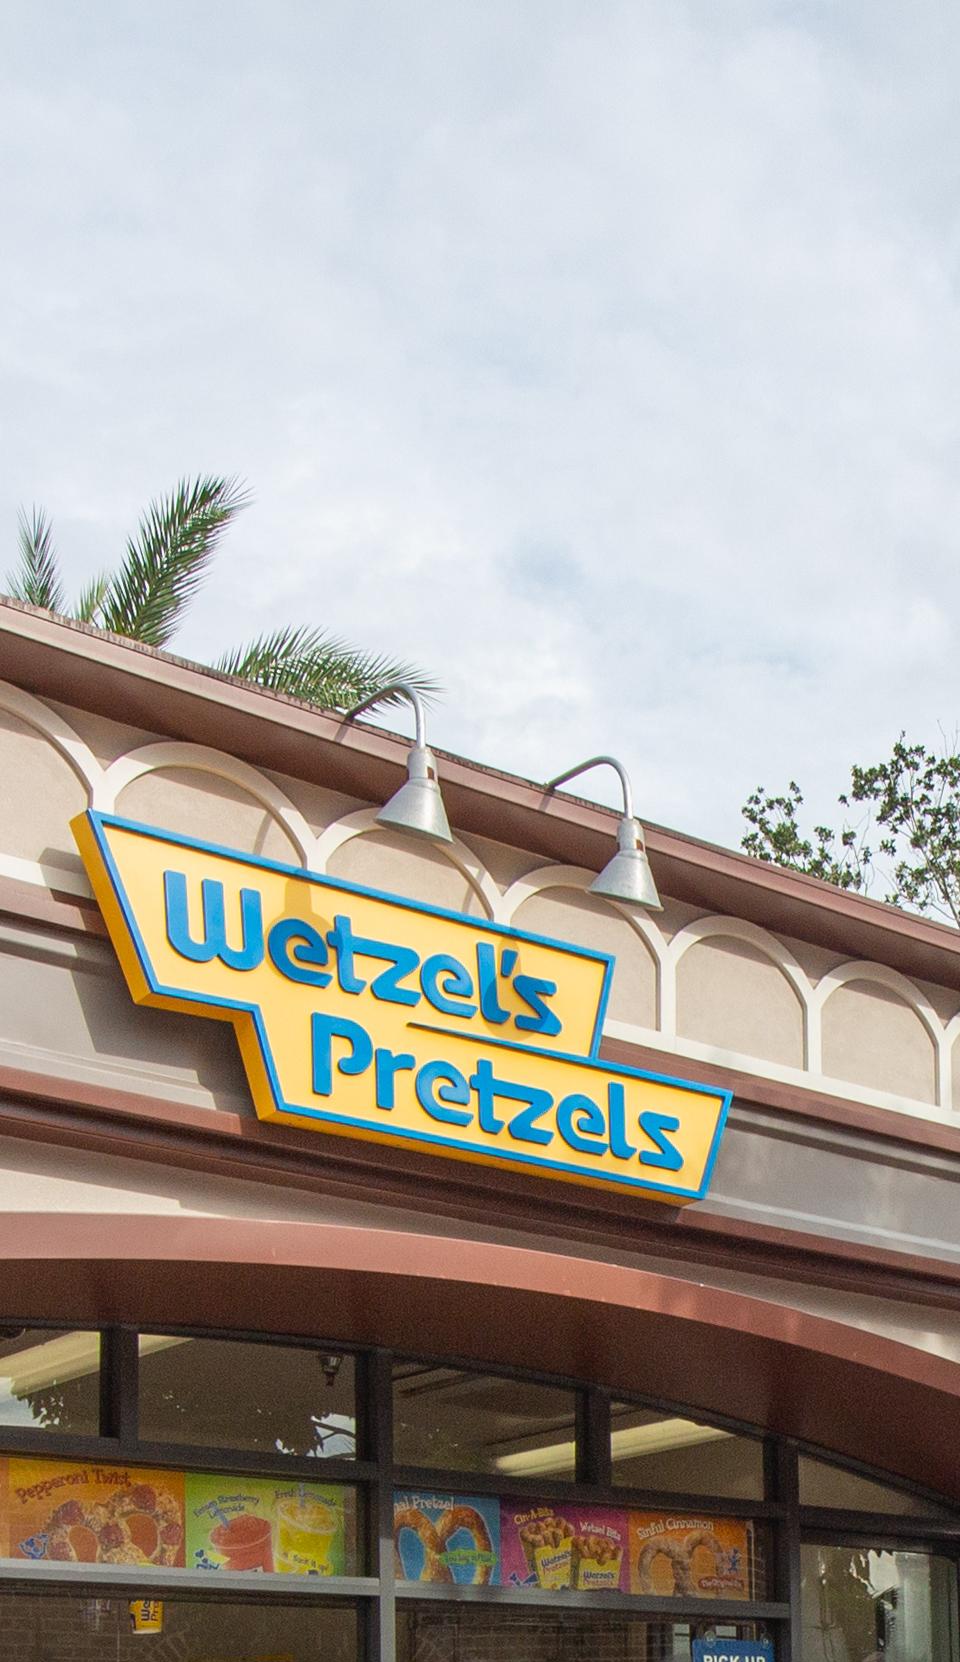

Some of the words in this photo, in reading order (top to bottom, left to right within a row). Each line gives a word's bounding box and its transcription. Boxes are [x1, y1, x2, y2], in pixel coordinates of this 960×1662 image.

[163, 869, 562, 1036] Wetzel's
[310, 1011, 685, 1171] Pretzels
[15, 1470, 89, 1504] Pepperoni
[92, 1468, 131, 1487] Twist
[411, 1495, 455, 1511] Pretzel
[636, 1519, 665, 1539] Sinful
[666, 1518, 714, 1531] Cinnamon
